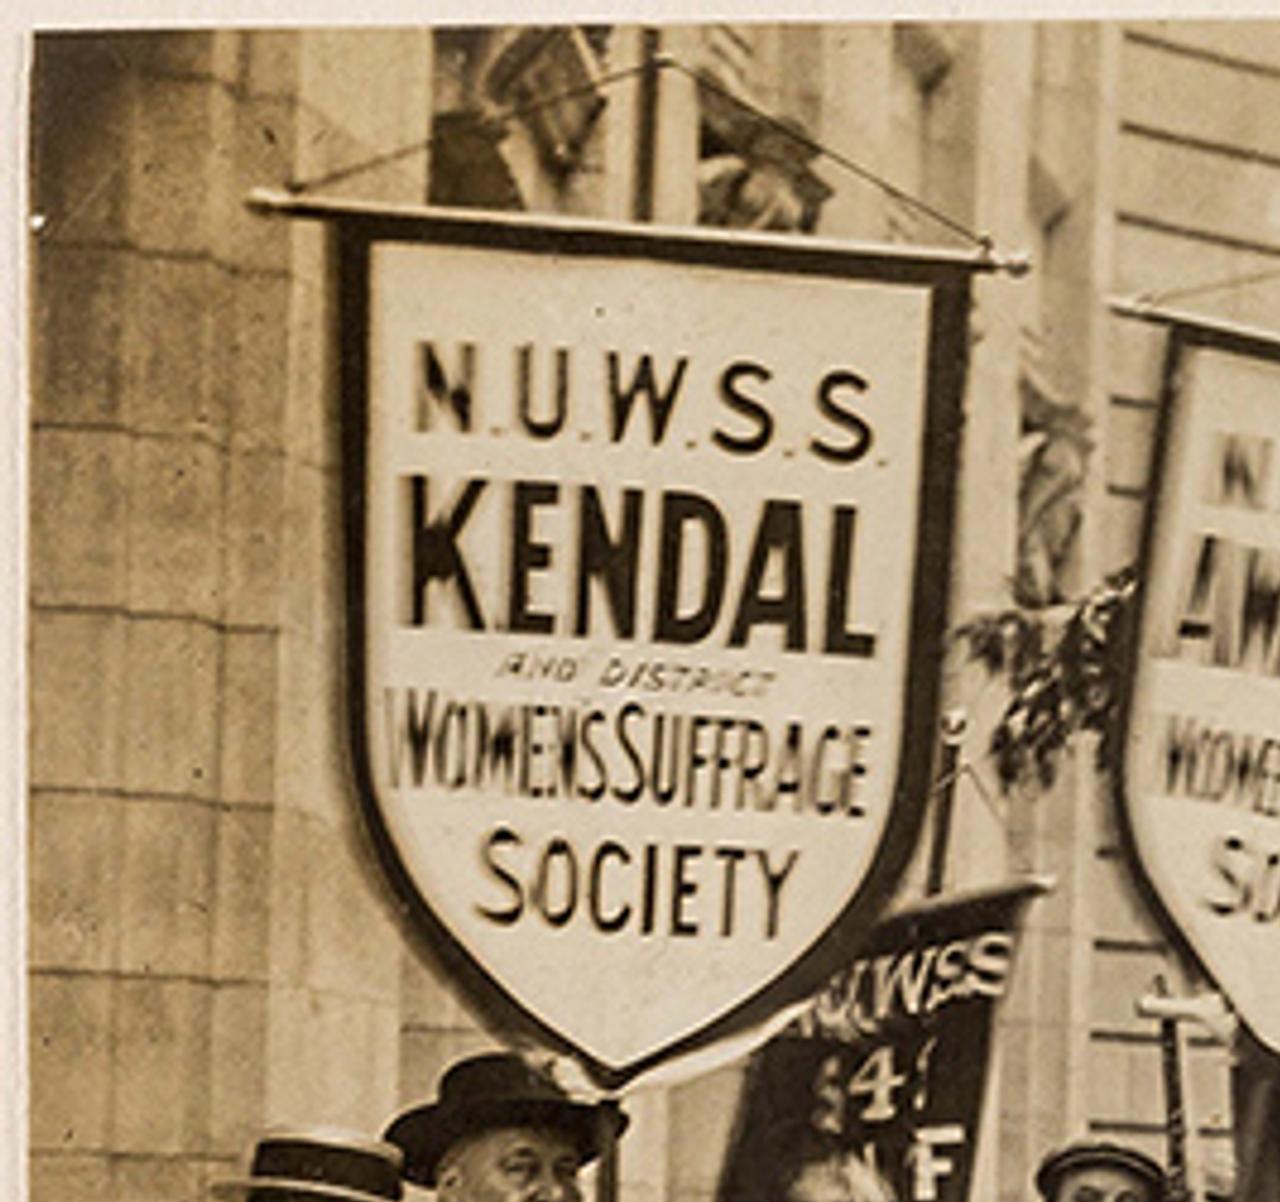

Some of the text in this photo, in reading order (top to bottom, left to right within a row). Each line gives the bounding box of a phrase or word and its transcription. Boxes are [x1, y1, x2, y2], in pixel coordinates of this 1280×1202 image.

[400, 474, 877, 658] KENDAL
[495, 652, 776, 697] AND DISTRICT
[475, 827, 800, 940] SOCIETY
